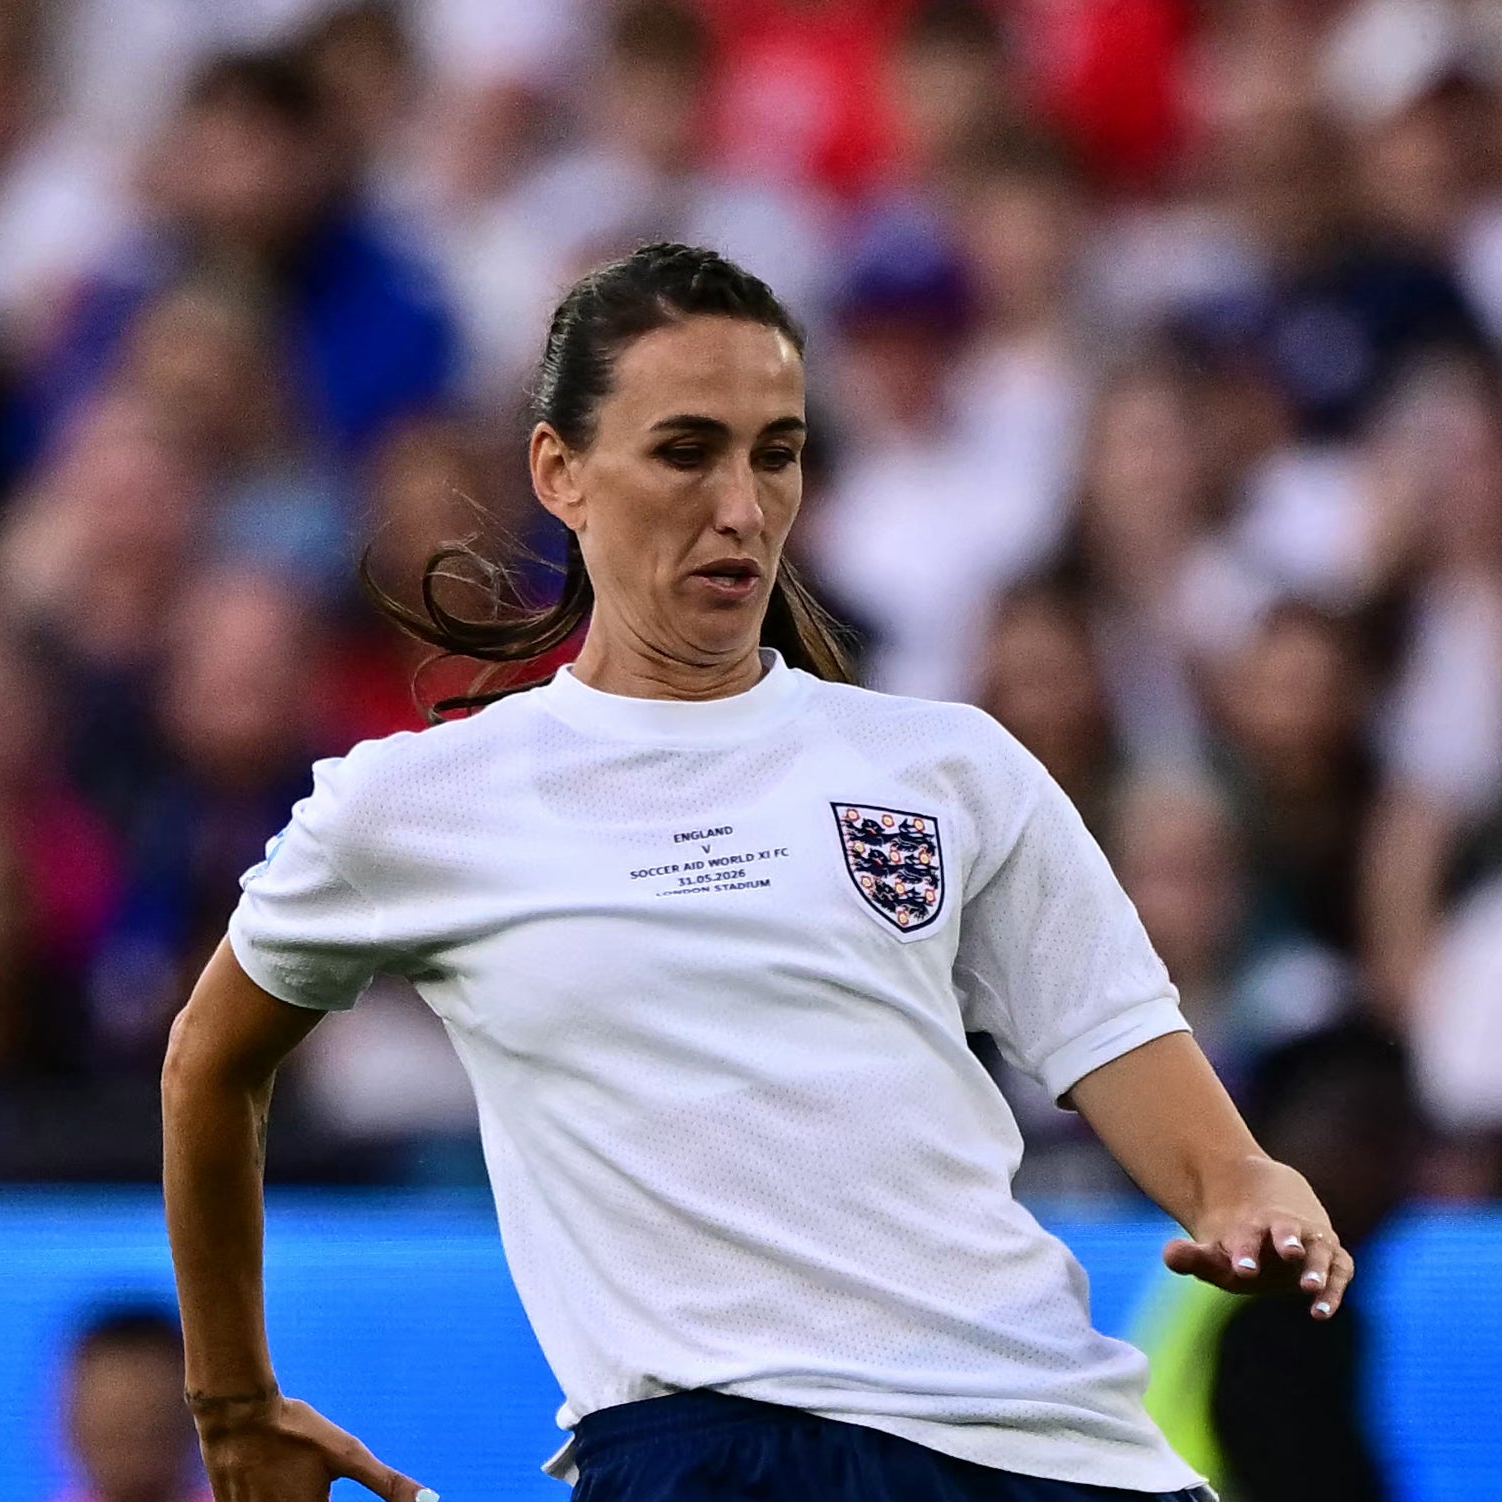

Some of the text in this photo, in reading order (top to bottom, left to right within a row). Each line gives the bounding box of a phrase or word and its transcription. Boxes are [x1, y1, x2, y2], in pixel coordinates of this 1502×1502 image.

[673, 826, 734, 843] ENGLAND
[701, 844, 711, 854] V
[630, 848, 789, 879] SOCCER AID WORLD XI FC
[678, 869, 746, 887] 31.05.2026
[714, 879, 771, 892] STADIUM
